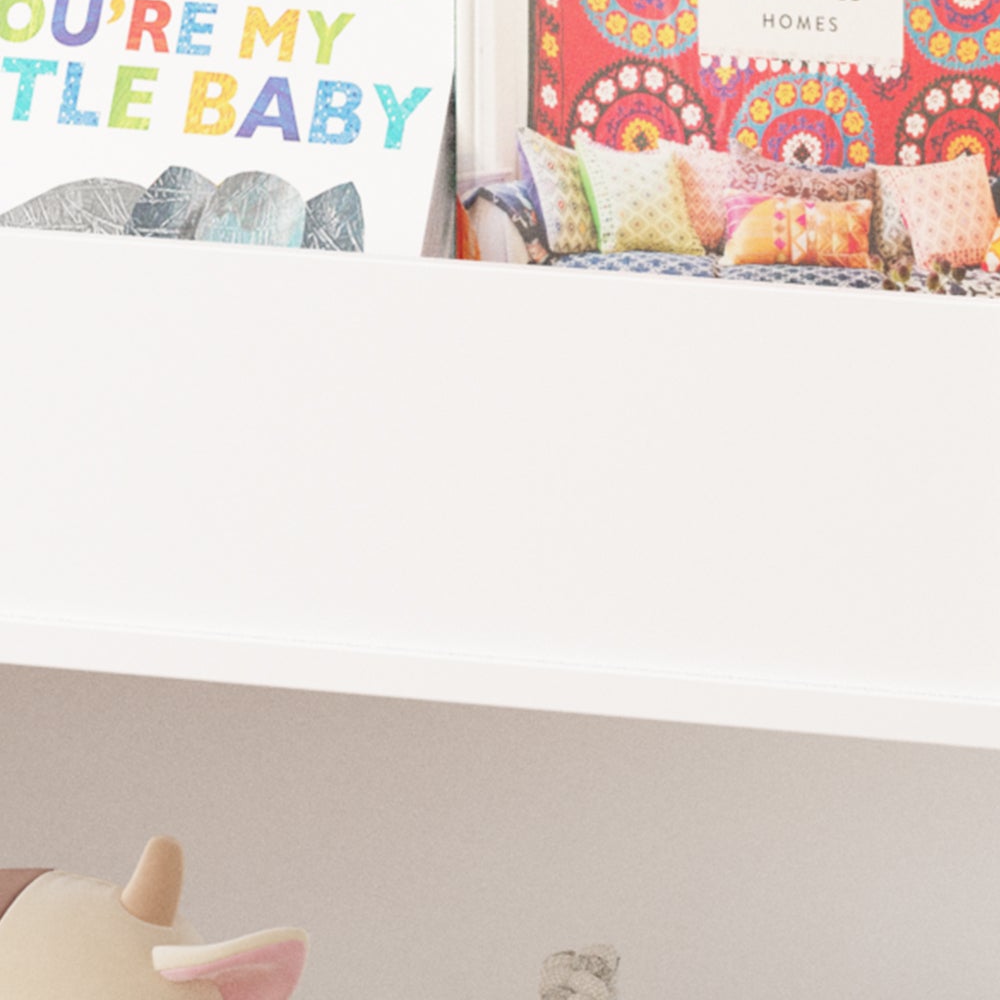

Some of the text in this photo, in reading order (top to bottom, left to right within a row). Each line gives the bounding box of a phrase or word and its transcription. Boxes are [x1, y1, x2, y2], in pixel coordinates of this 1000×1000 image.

[239, 5, 355, 65] MY
[762, 14, 838, 32] HOMES
[1, 56, 432, 151] TLE BABY
